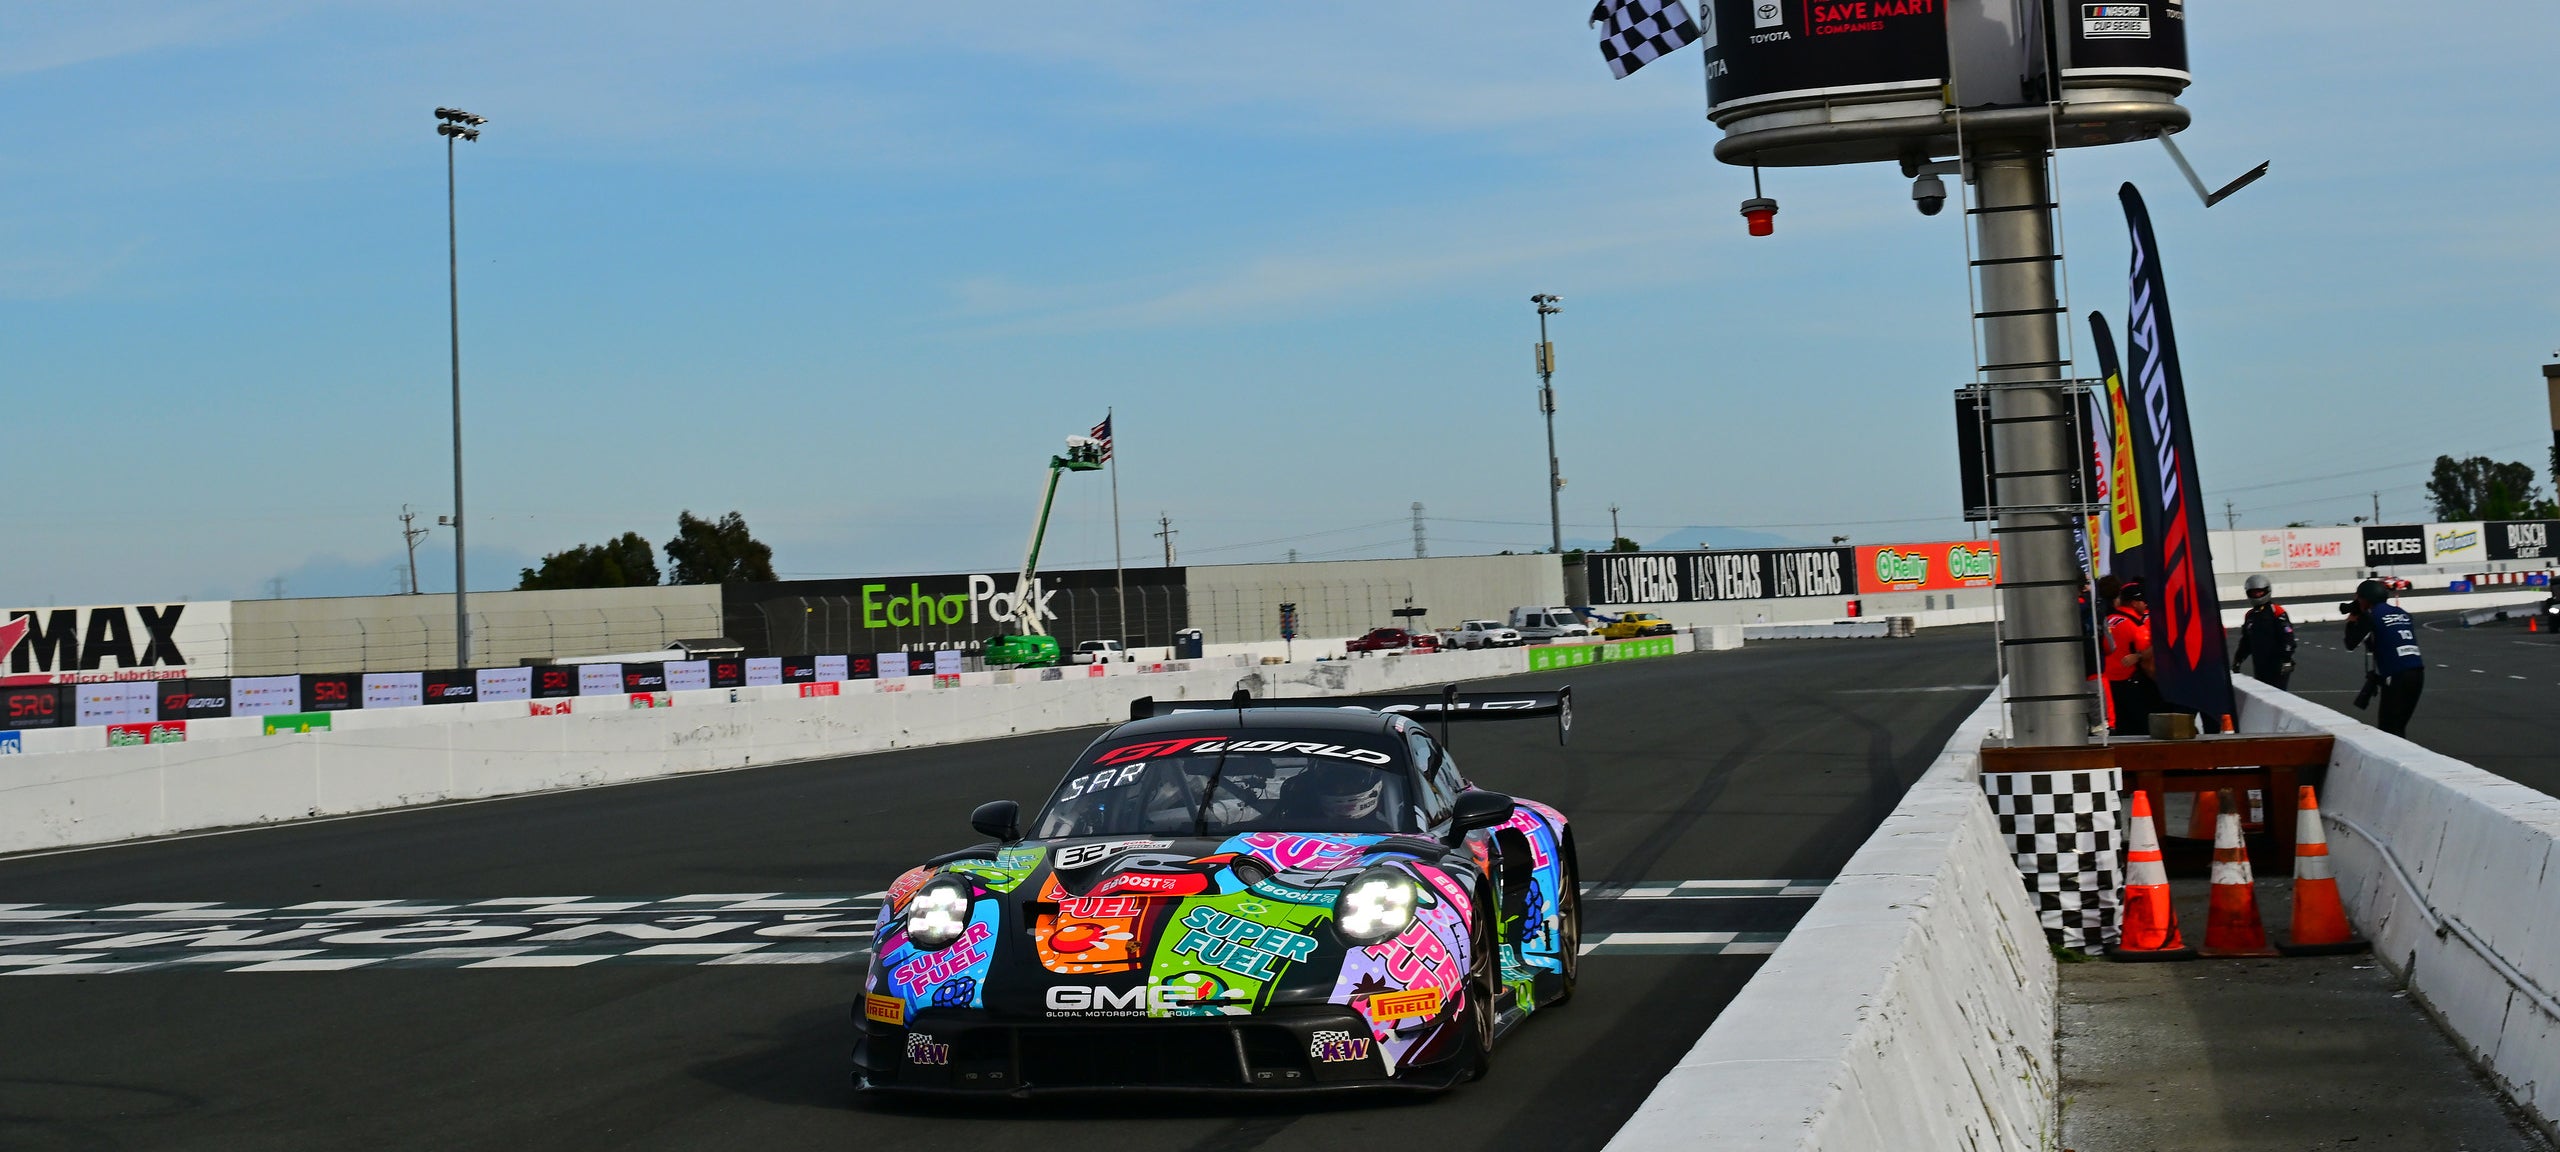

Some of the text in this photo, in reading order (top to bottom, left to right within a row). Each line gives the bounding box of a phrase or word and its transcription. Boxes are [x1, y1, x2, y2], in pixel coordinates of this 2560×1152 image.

[1814, 0, 1934, 23] SAVE MART
[2101, 6, 2141, 17] NASCAR
[1816, 20, 1885, 36] COMPANIES
[2093, 21, 2141, 31] CUP SERIES
[1750, 31, 1791, 45] TOYOTA
[2507, 523, 2547, 549] BUSCH
[2288, 542, 2313, 558] SAVE
[2315, 541, 2341, 557] MART
[1689, 554, 1763, 601] LAS VEGAS
[1772, 551, 1842, 598] LAS VEGAS
[1876, 550, 1928, 584] O'Reilly
[1602, 556, 1679, 604] LAS VEGAS
[862, 574, 1059, 629] EchoPak
[59, 668, 188, 685] Micro-lubricant
[543, 671, 568, 689] SRO
[314, 681, 347, 700] SRO
[9, 694, 55, 717] SRO
[1190, 741, 1392, 765] WORLD
[1061, 763, 1146, 802] SAR
[1063, 844, 1106, 865] 32
[1101, 875, 1162, 893] EBOOST
[1255, 880, 1322, 902] EBOOST
[1058, 895, 1141, 918] FUEL
[176, 914, 846, 932] ACEWAY
[1181, 905, 1319, 963] SUPER
[1173, 929, 1276, 982] FUEL
[911, 947, 988, 997] FUEL
[1397, 916, 1466, 1022] UPER
[866, 997, 901, 1020] PIRELLI
[1046, 985, 1198, 1010] GMG
[1377, 992, 1436, 1016] PIRELLI
[913, 1043, 949, 1065] KW
[1322, 1037, 1370, 1063] KW
